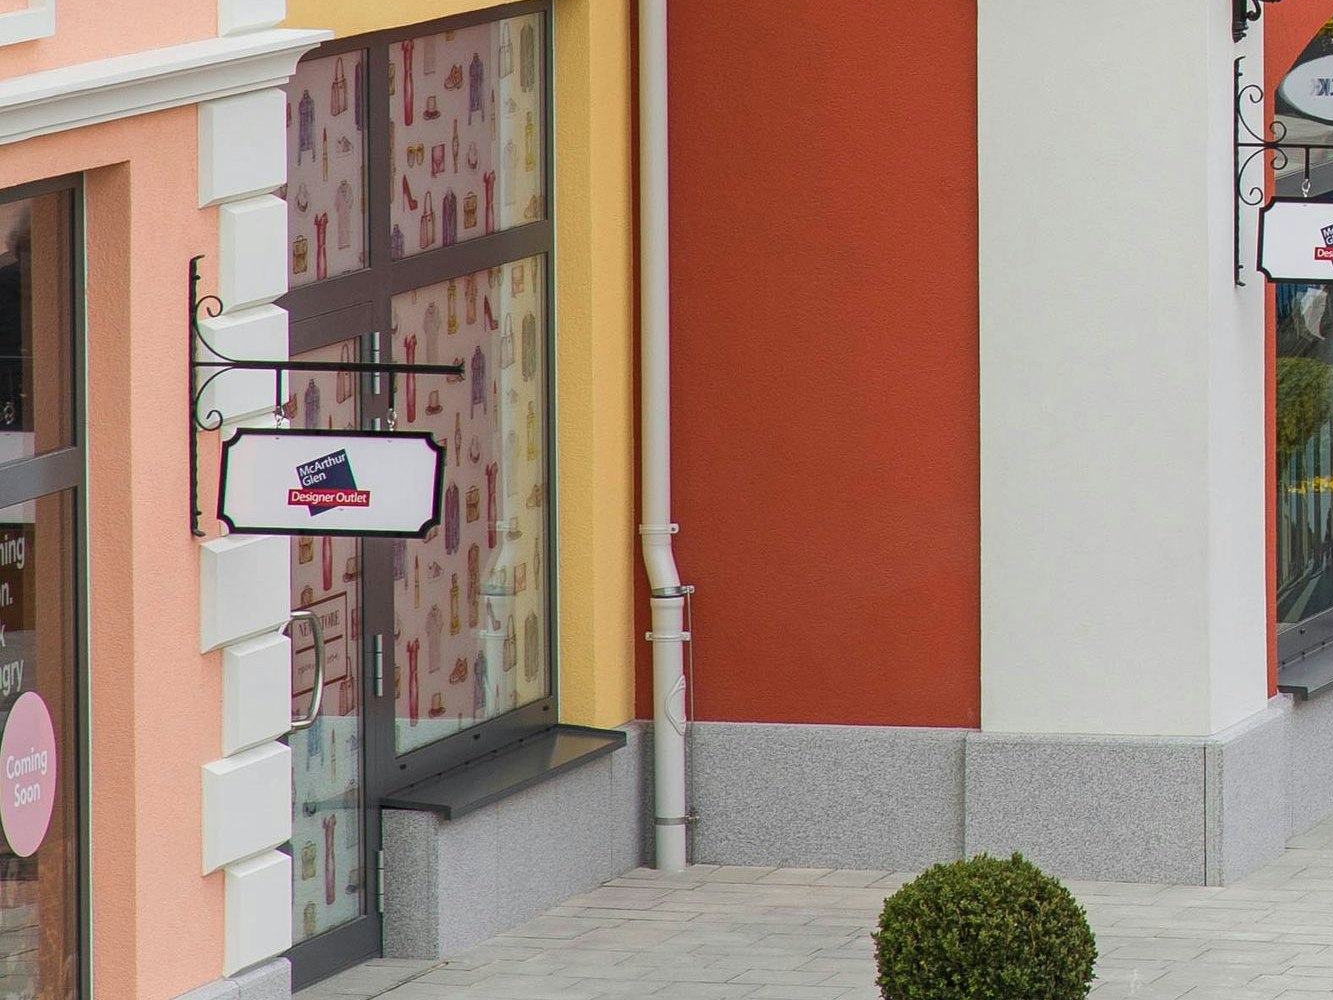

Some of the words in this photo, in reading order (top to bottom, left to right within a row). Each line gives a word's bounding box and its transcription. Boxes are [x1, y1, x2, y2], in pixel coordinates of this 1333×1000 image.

[299, 453, 346, 477] McArthur
[302, 471, 326, 486] Glen
[291, 491, 335, 504] Designer
[336, 491, 367, 503] Outlet
[6, 747, 48, 779] Coming
[14, 783, 41, 807] Soon
